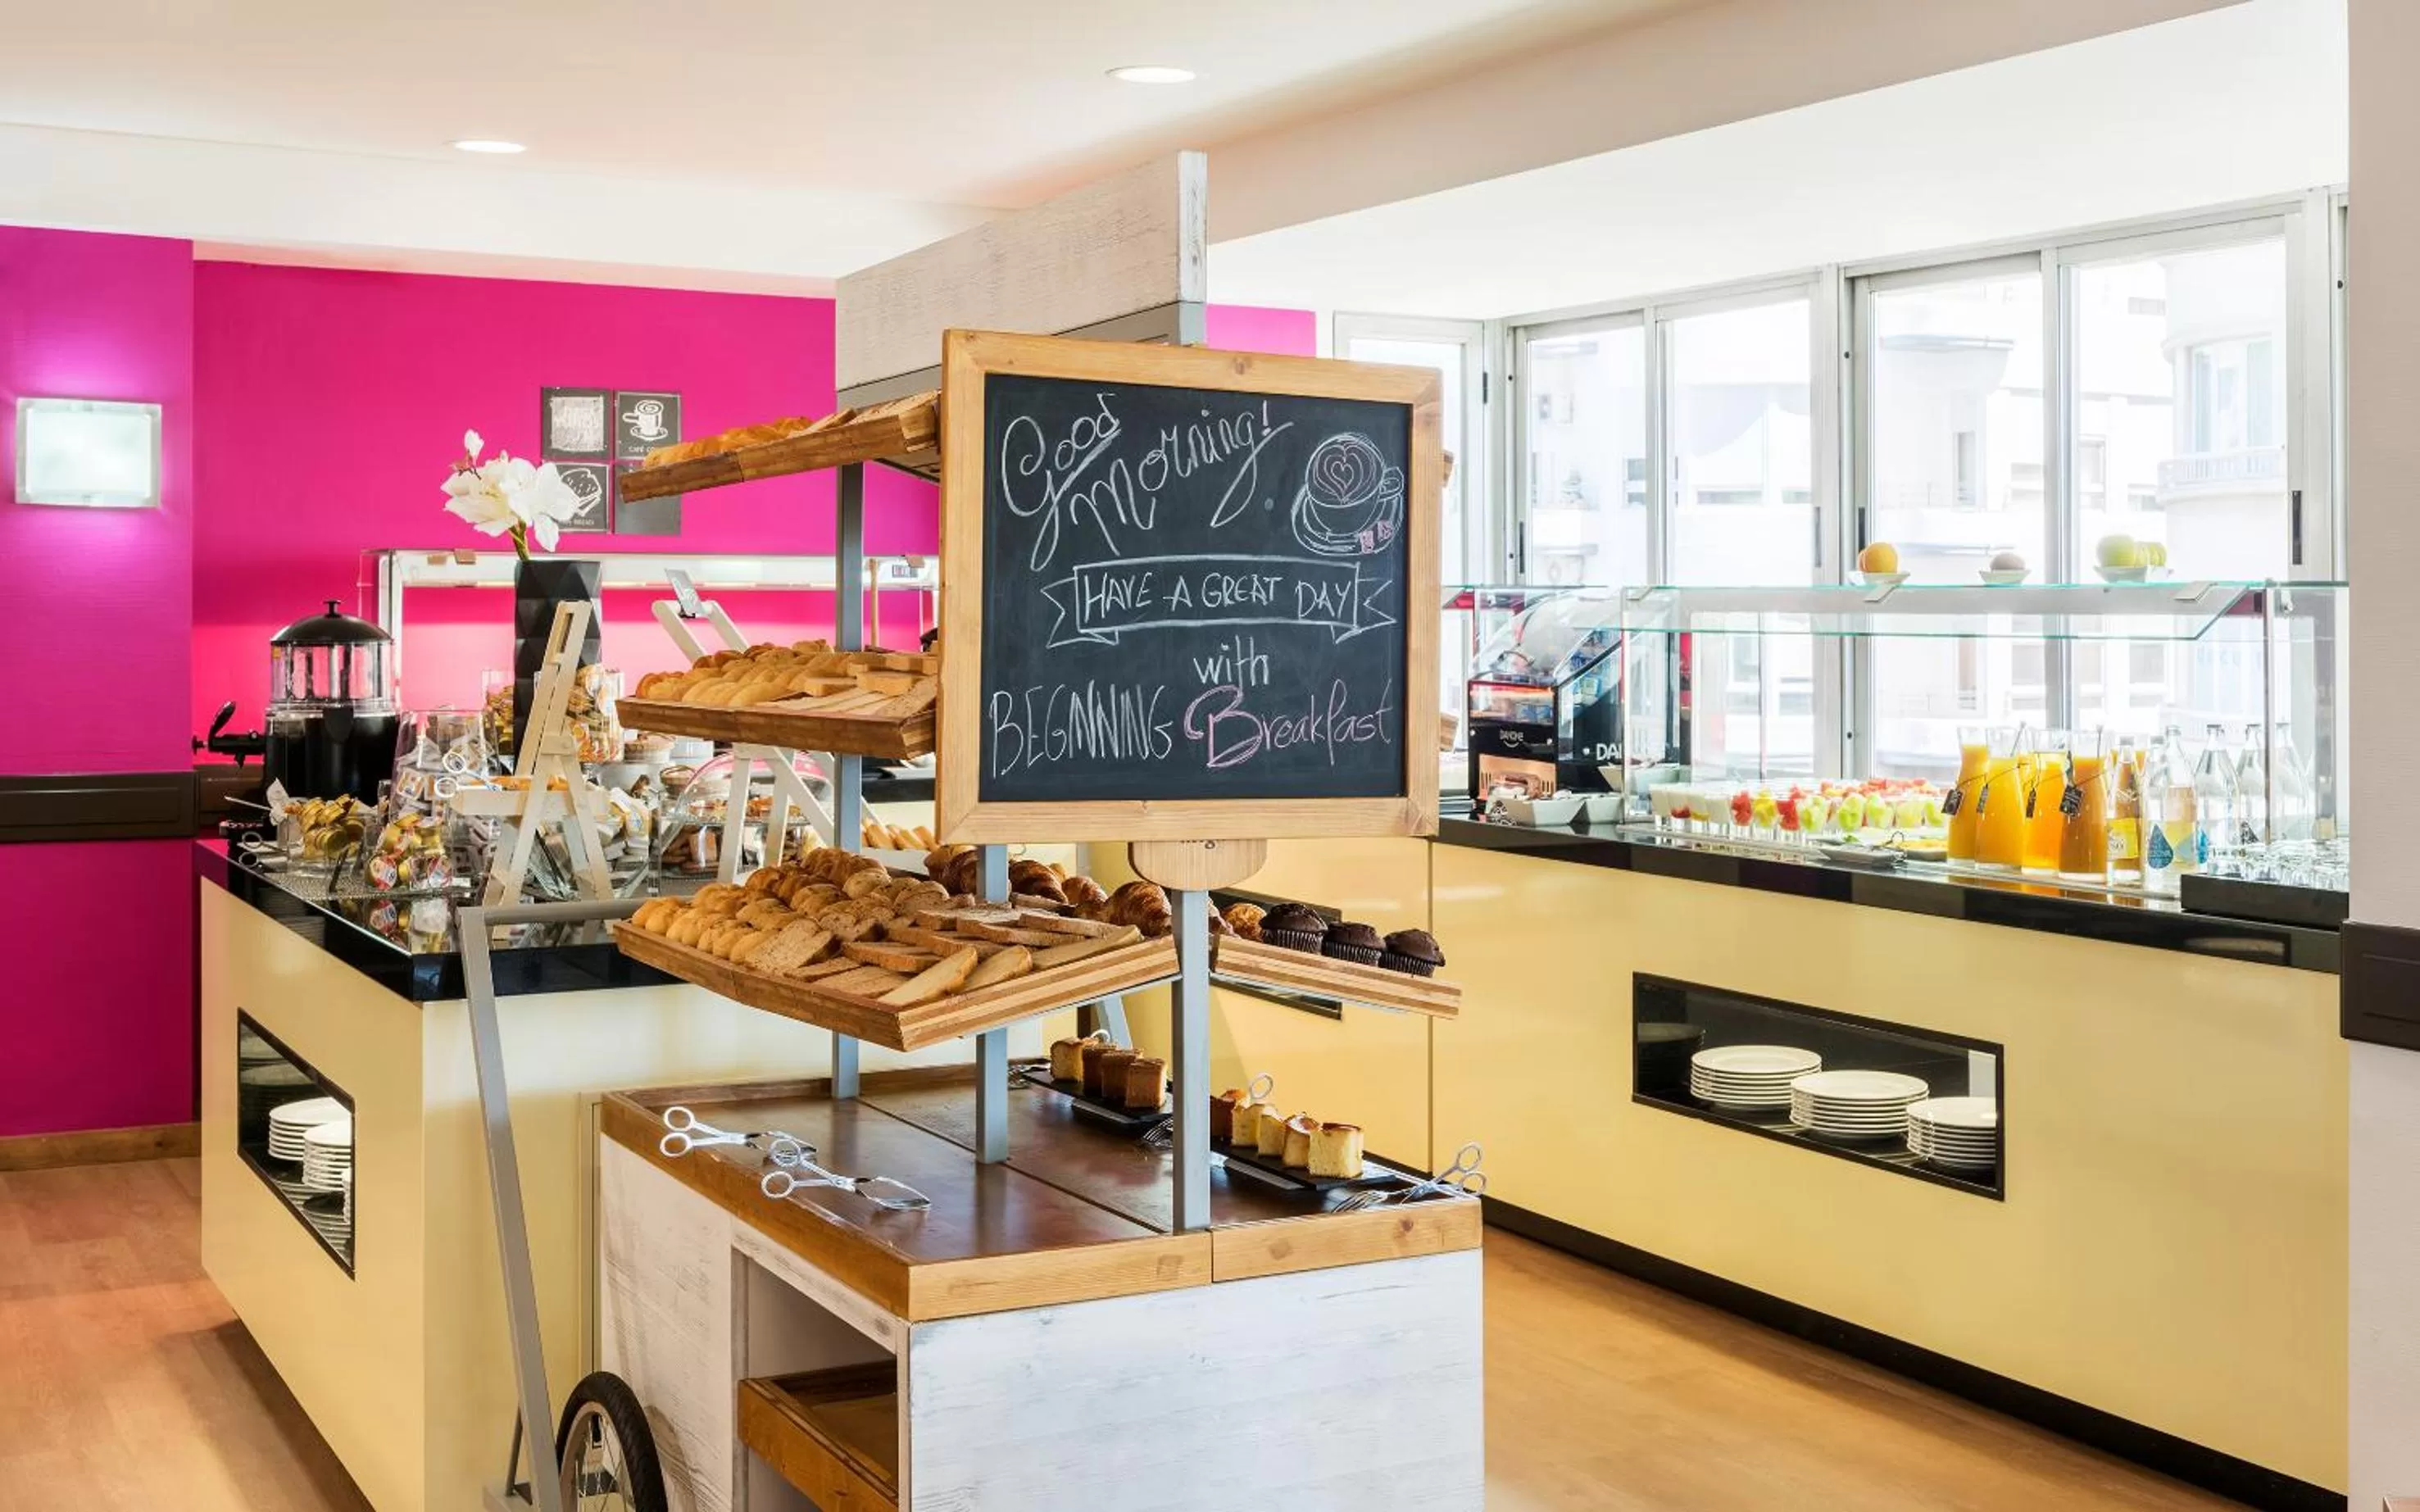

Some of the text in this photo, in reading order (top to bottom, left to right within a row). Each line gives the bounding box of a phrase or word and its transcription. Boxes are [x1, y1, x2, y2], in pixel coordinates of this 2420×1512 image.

[1001, 393, 1122, 572] Good
[1083, 572, 1352, 624] HAVE A GREAT DAY
[1192, 634, 1270, 688] with
[1183, 678, 1393, 769] Breakfast
